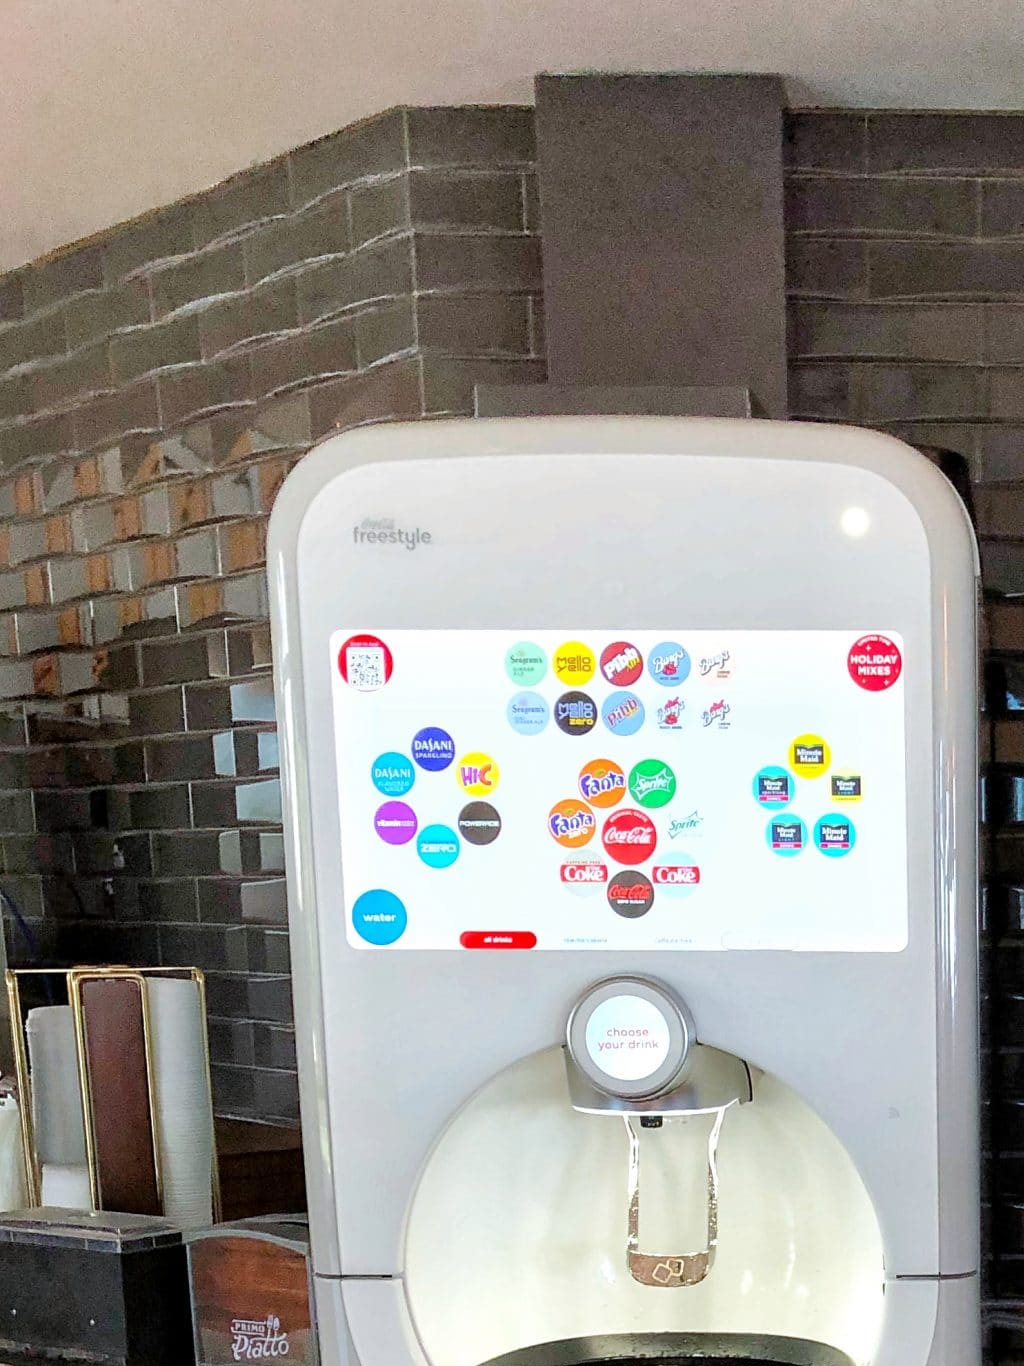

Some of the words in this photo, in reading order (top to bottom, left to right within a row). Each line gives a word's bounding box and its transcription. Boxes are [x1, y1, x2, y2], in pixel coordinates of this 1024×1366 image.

[353, 526, 431, 551] freestyle
[850, 655, 897, 664] HOLIDAY
[858, 666, 891, 676] MIXES
[414, 739, 452, 752] DASANI
[374, 767, 411, 780] DASANI
[579, 771, 625, 799] Fanta
[549, 810, 593, 837] Fanta
[669, 818, 700, 832] Sprite
[563, 865, 604, 882] Coke
[656, 867, 697, 883] Coke
[363, 912, 397, 922] water
[606, 1027, 649, 1037] choose
[598, 1041, 625, 1051] your
[628, 1039, 659, 1049] drink
[234, 1322, 266, 1333] PRIMO
[231, 1332, 290, 1361] Piatto
